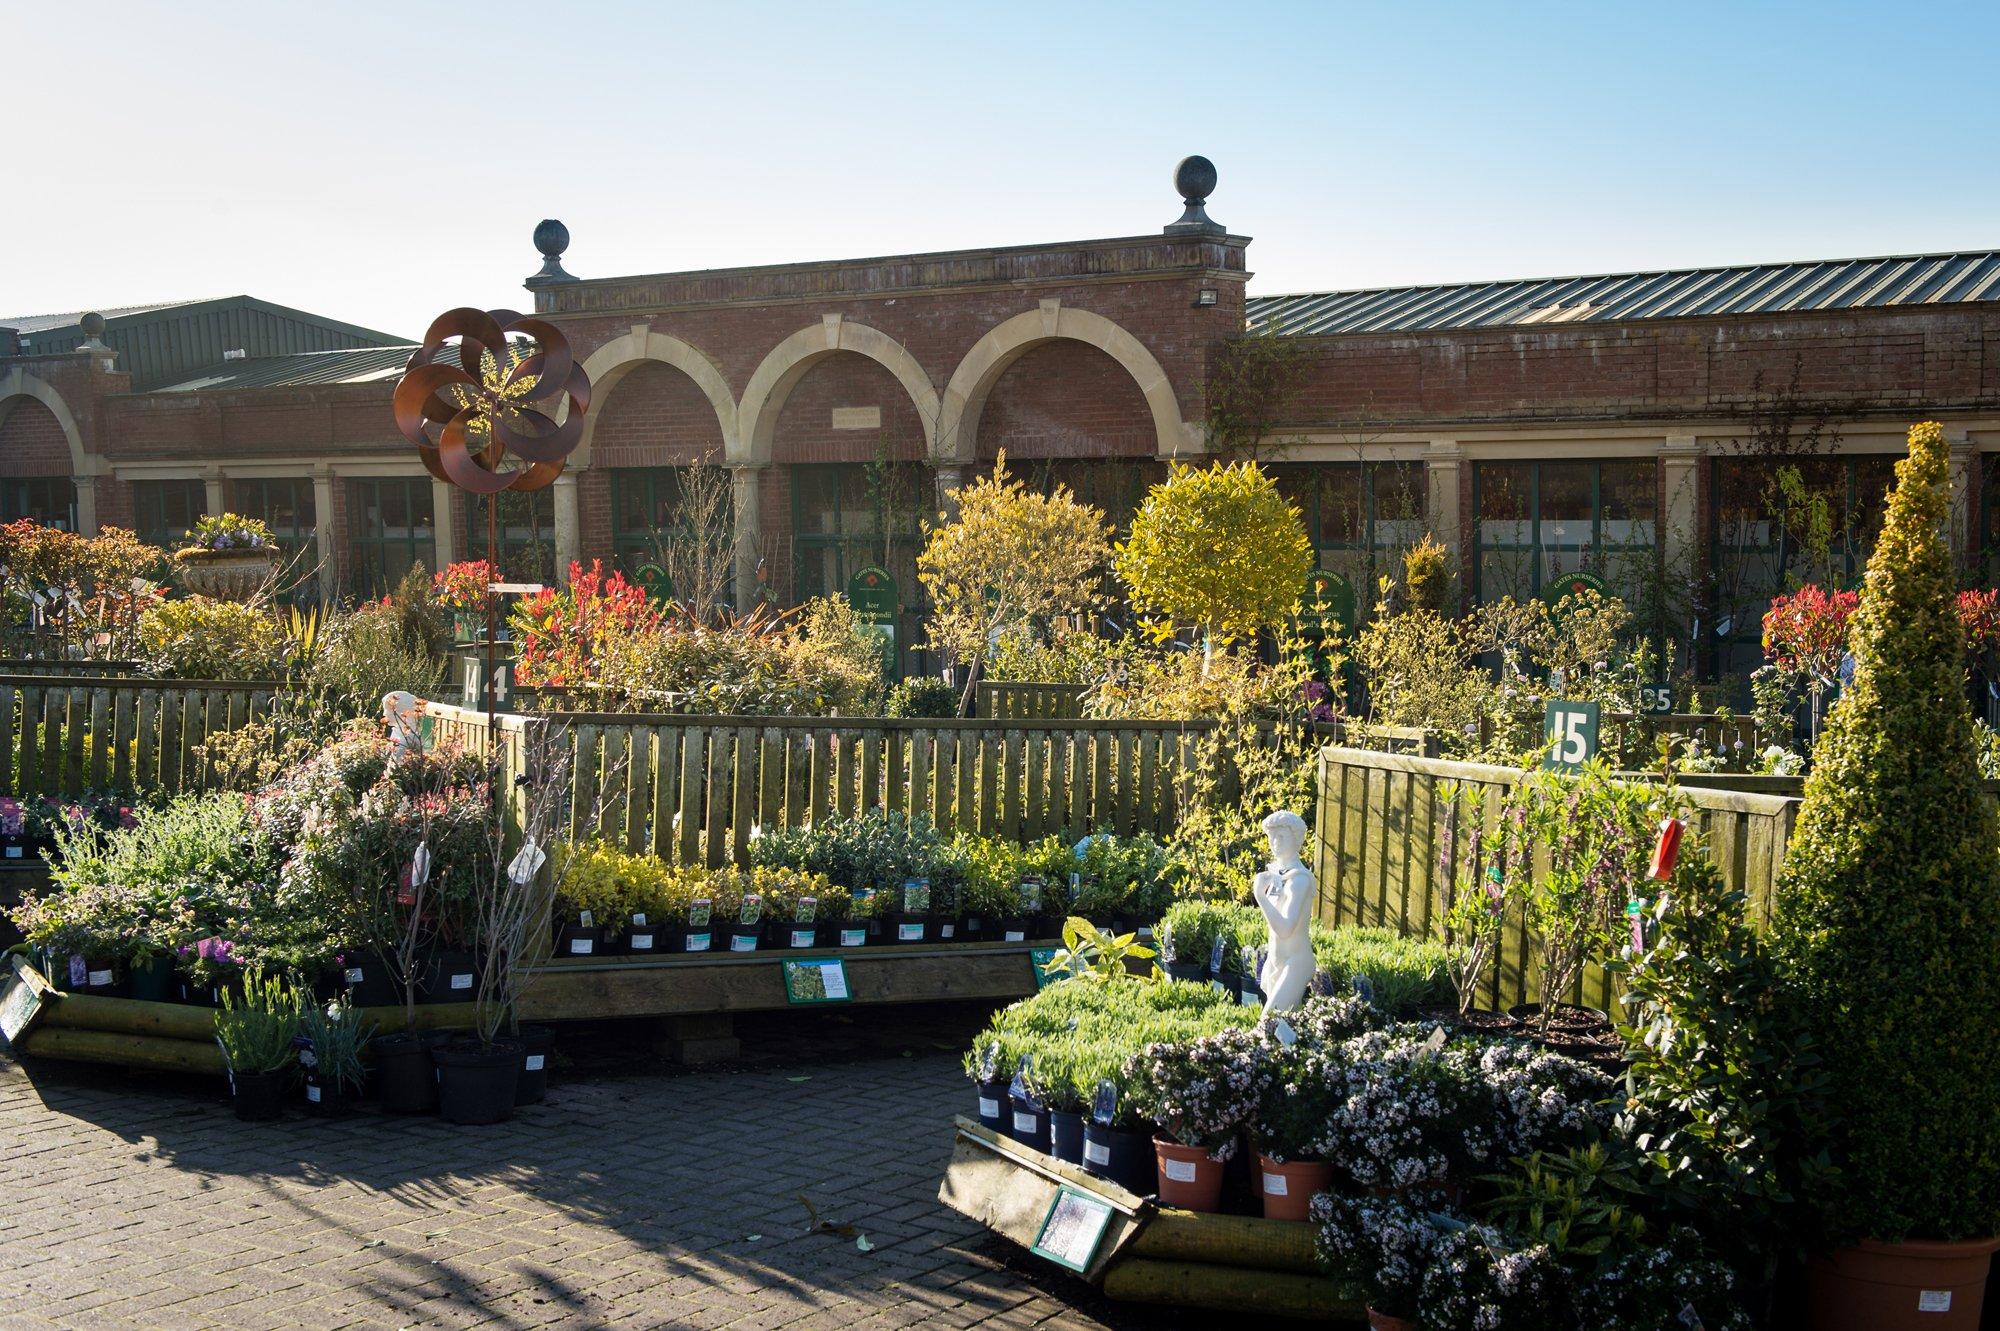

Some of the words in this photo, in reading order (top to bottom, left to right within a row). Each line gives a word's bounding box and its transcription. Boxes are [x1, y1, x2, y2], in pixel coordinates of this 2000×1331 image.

[855, 568, 868, 580] GATES
[1554, 575, 1572, 589] GATES
[1571, 573, 1604, 590] NURSERIES
[865, 601, 880, 609] Acer
[464, 664, 478, 703] 14
[1551, 711, 1588, 764] 15
